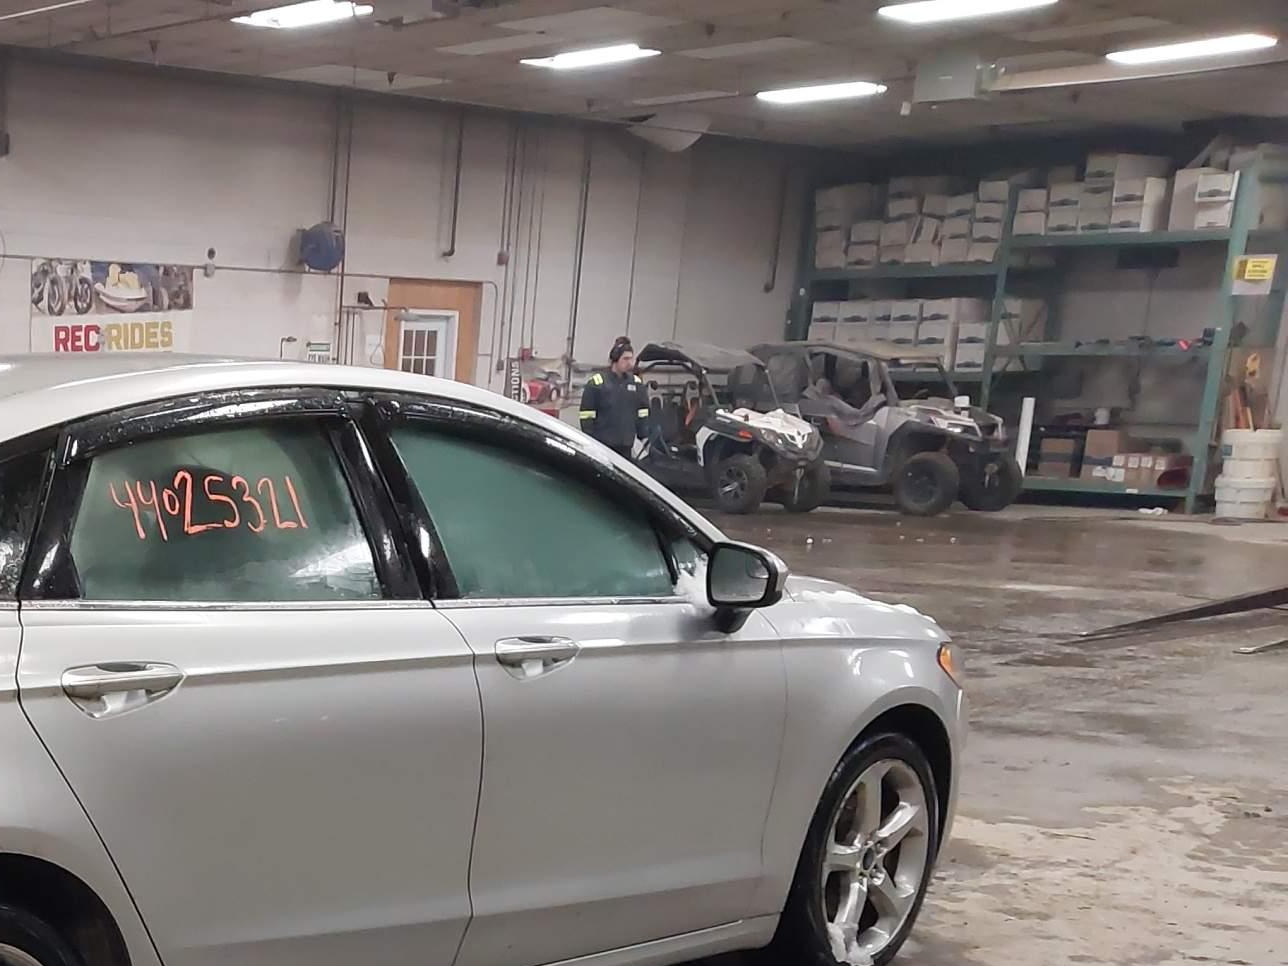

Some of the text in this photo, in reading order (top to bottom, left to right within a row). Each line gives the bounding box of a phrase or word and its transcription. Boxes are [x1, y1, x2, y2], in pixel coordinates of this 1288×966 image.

[54, 321, 173, 352] REC RIDES
[109, 470, 309, 541] 44025321
